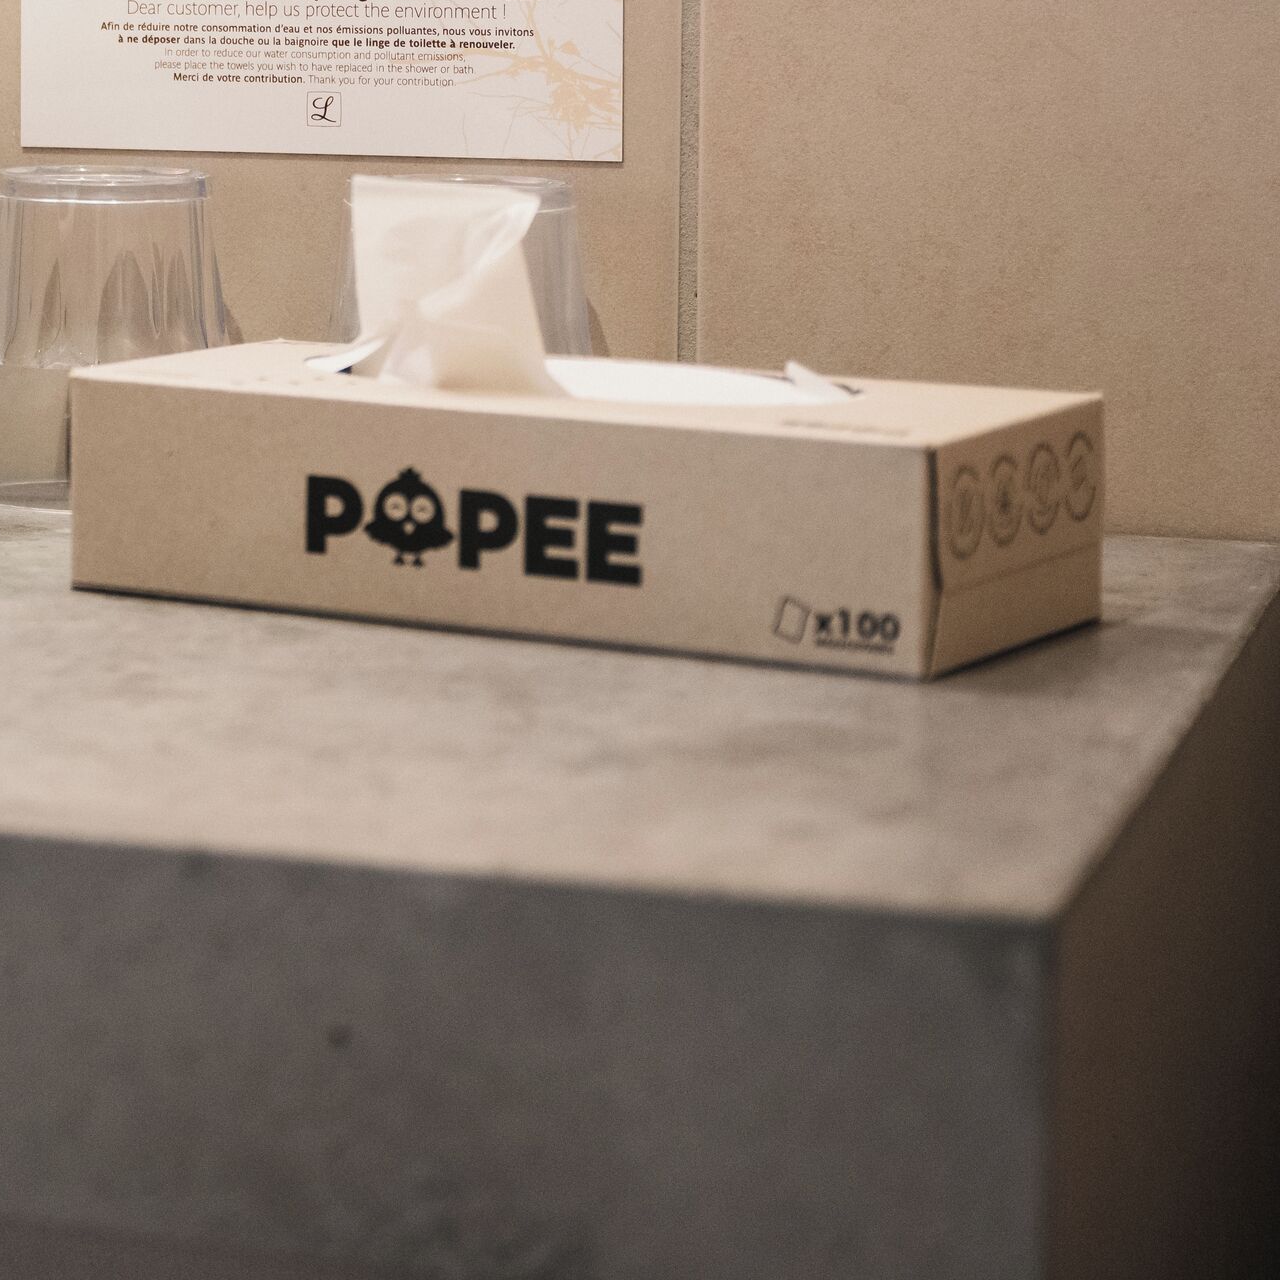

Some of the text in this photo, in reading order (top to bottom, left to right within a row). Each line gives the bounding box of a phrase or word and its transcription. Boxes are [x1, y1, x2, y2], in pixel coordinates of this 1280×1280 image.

[127, 0, 506, 19] Dear customer, help us protect the environment !
[101, 22, 119, 31] Afin
[124, 23, 134, 31] de
[138, 23, 170, 32] réduire
[174, 24, 198, 32] notre
[202, 24, 271, 33] consommation
[304, 25, 312, 33] et
[337, 25, 383, 35] émissions
[387, 26, 439, 37] polluantes,
[443, 28, 465, 36] nous
[495, 28, 534, 37] invitons
[118, 34, 123, 43] à
[142, 35, 180, 45] déposer
[184, 36, 205, 44] dans
[209, 36, 216, 44] la
[220, 36, 254, 45] douche
[273, 37, 281, 45] la
[285, 37, 328, 47] baignoire
[332, 39, 350, 48] que
[354, 38, 362, 46] le
[366, 38, 390, 49] linge
[394, 38, 405, 47] de
[409, 39, 446, 48] toilette
[450, 39, 455, 48] à
[459, 40, 515, 49] renouveler.
[165, 48, 172, 56] In
[176, 49, 198, 57] order
[214, 49, 243, 57] reduce
[264, 50, 287, 58] water
[291, 51, 350, 60] consumption
[354, 51, 371, 60] and
[375, 52, 414, 61] pollutant
[418, 53, 465, 62] emissions,
[155, 61, 181, 70] please
[184, 61, 207, 70] place
[210, 61, 224, 69] the
[227, 62, 254, 70] towels
[258, 64, 273, 72] you
[277, 63, 296, 71] wish
[312, 64, 332, 72] have
[336, 64, 372, 73] replaced
[388, 65, 402, 73] the
[406, 65, 437, 74] shower
[174, 73, 199, 81] Merci
[203, 73, 214, 82] de
[244, 74, 305, 83] contribution.
[309, 75, 335, 84] Thank
[339, 77, 355, 86] you
[358, 76, 370, 84] for
[374, 77, 393, 86] your
[397, 76, 456, 86] contribution.
[815, 607, 900, 642] x100
